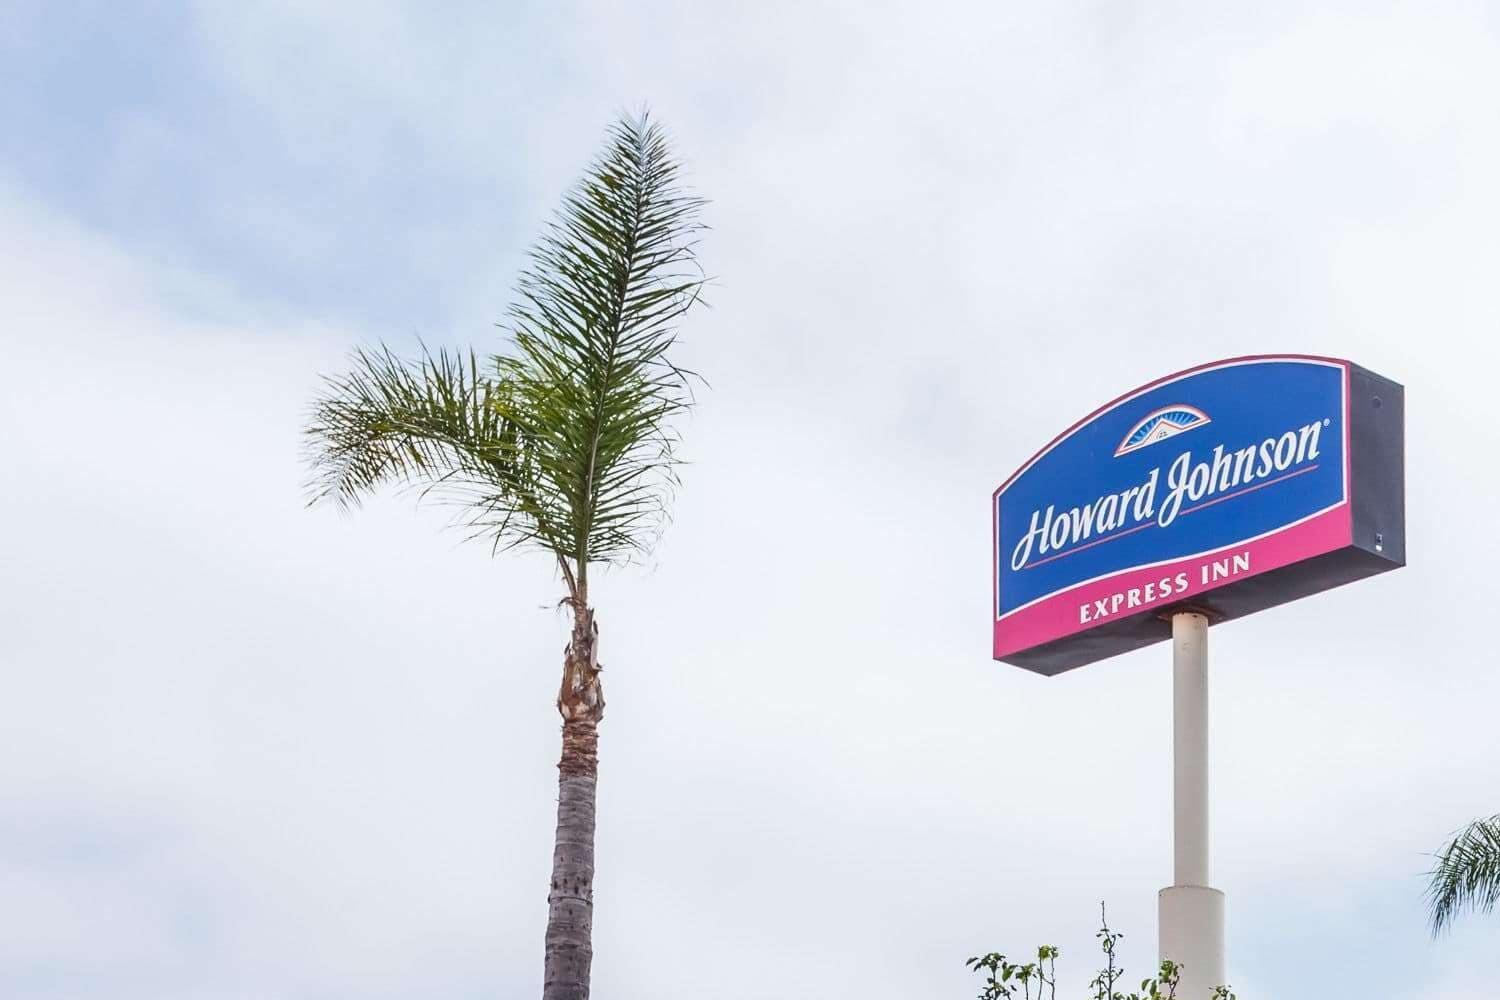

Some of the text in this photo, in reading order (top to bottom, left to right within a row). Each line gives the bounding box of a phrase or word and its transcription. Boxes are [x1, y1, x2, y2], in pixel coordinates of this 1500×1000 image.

[1011, 419, 1321, 571] Howard Johnson
[1079, 552, 1251, 625] EXPRESS INN
